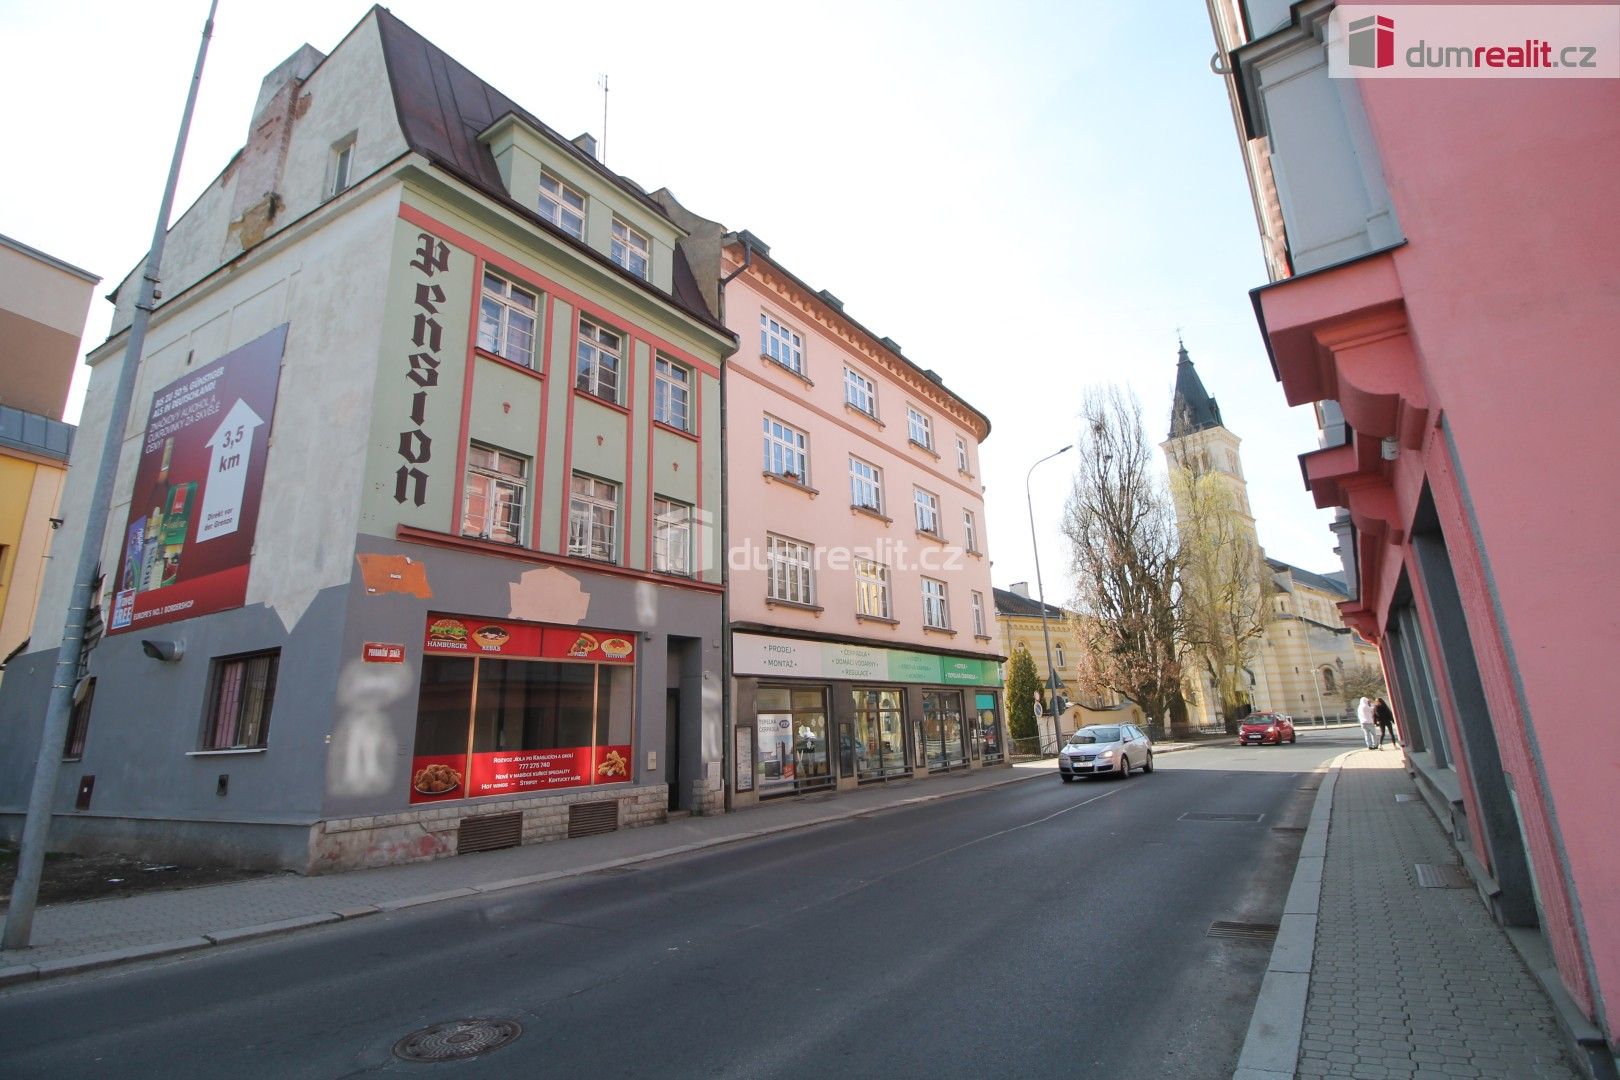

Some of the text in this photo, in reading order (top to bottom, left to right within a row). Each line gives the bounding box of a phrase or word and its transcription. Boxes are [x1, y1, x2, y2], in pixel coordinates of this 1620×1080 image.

[393, 232, 451, 508] Pension
[222, 424, 245, 449] 3,5
[218, 454, 240, 473] km
[207, 510, 224, 521] Direkt
[214, 517, 232, 528] Grenze
[427, 640, 468, 650] HAMBURGER
[768, 645, 792, 654] PRODEJ
[768, 660, 793, 668] MONTÁŽ
